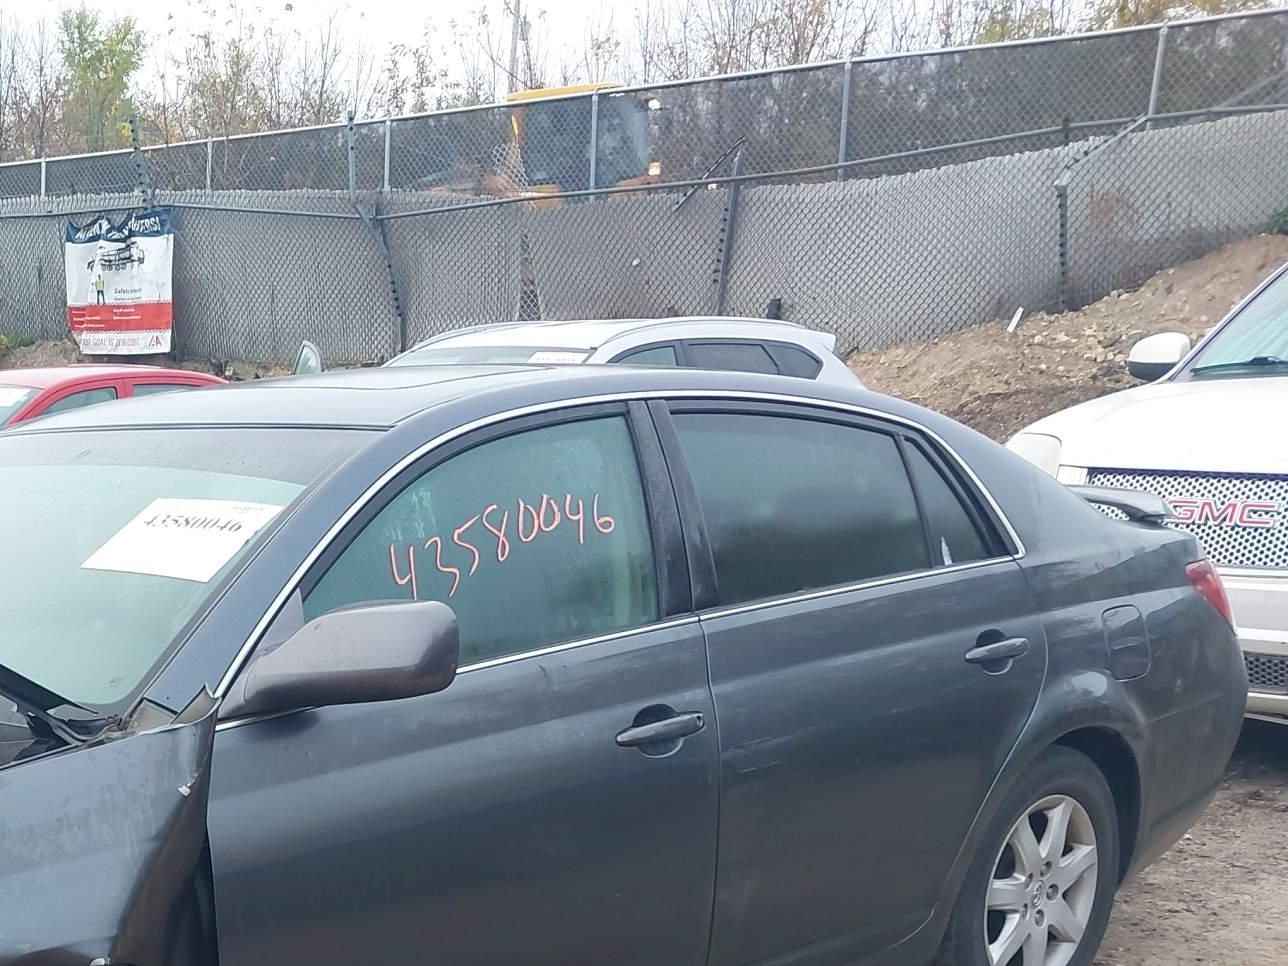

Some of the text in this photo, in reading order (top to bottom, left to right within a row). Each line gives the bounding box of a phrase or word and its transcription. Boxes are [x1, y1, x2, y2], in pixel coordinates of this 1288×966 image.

[143, 514, 243, 532] 43580046
[1167, 499, 1282, 528] GMC
[390, 493, 616, 601] 43580046
